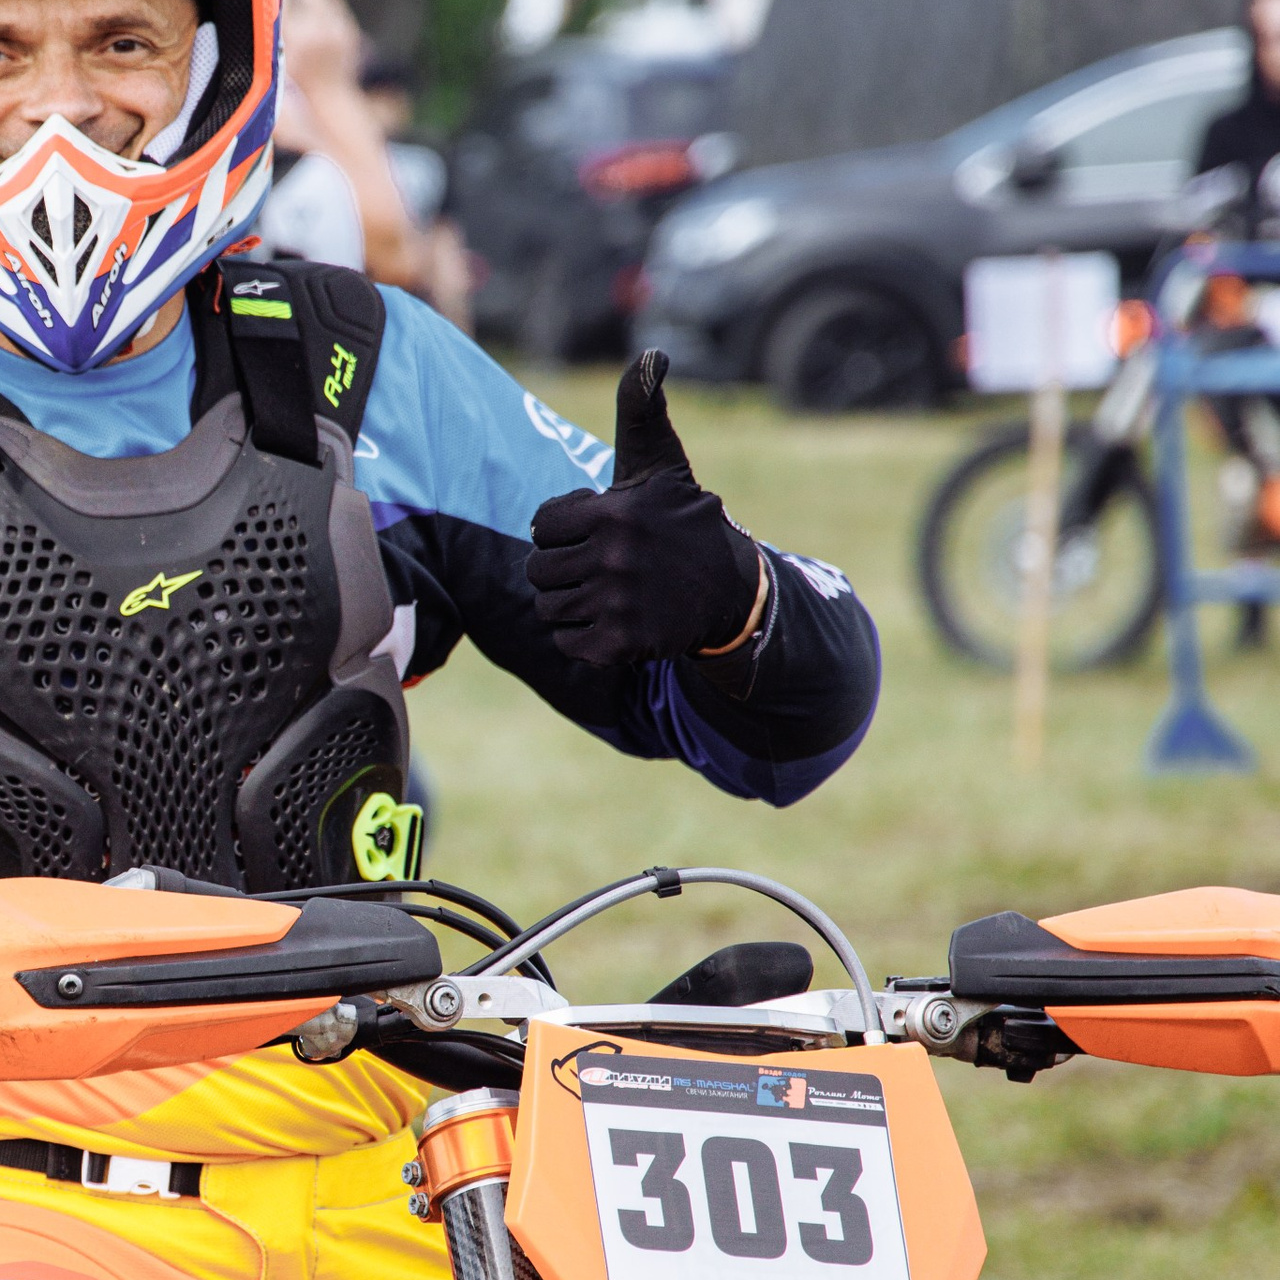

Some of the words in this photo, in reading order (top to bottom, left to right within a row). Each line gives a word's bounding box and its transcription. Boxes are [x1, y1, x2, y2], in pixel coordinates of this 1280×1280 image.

[4, 251, 54, 329] Airoh
[92, 231, 128, 332] Airoh
[324, 342, 350, 408] A-4
[685, 1087, 708, 1098] СВЕЧИ
[708, 1089, 748, 1100] ЗАЖИГАНИЯ
[607, 1127, 874, 1266] 303
